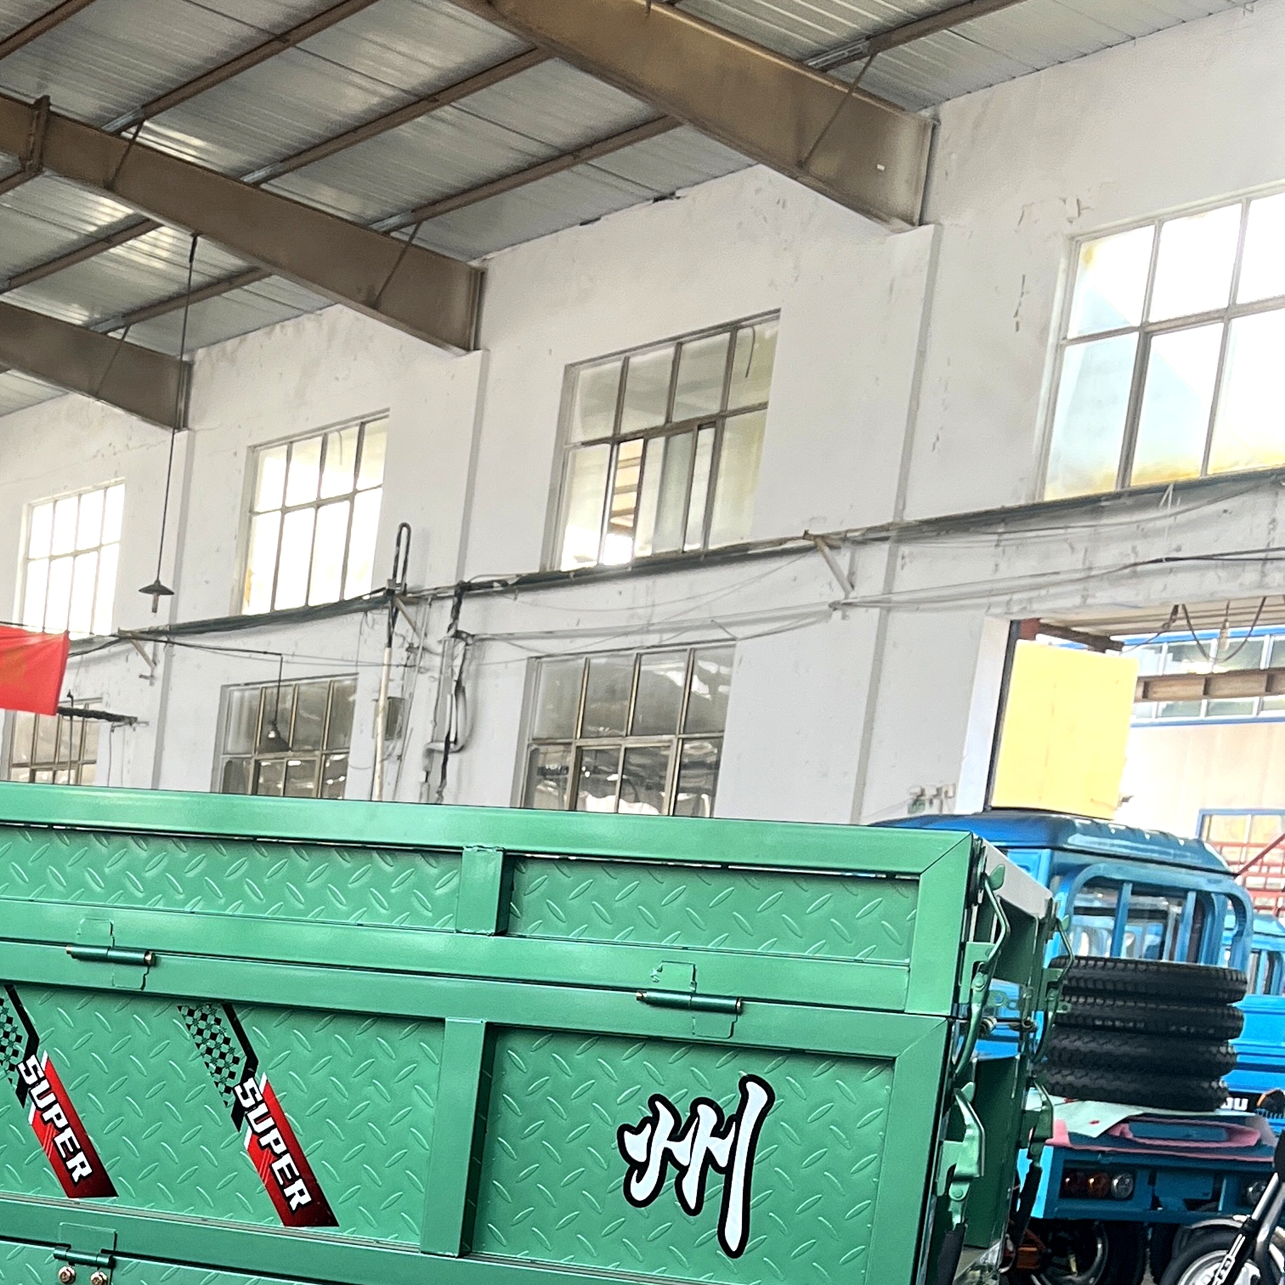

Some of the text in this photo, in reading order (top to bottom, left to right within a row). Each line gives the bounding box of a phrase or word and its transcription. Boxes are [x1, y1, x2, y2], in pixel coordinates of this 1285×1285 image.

[17, 1055, 93, 1184] SUPER
[234, 1077, 312, 1211] SUPER
[616, 1073, 775, 1259] 州
